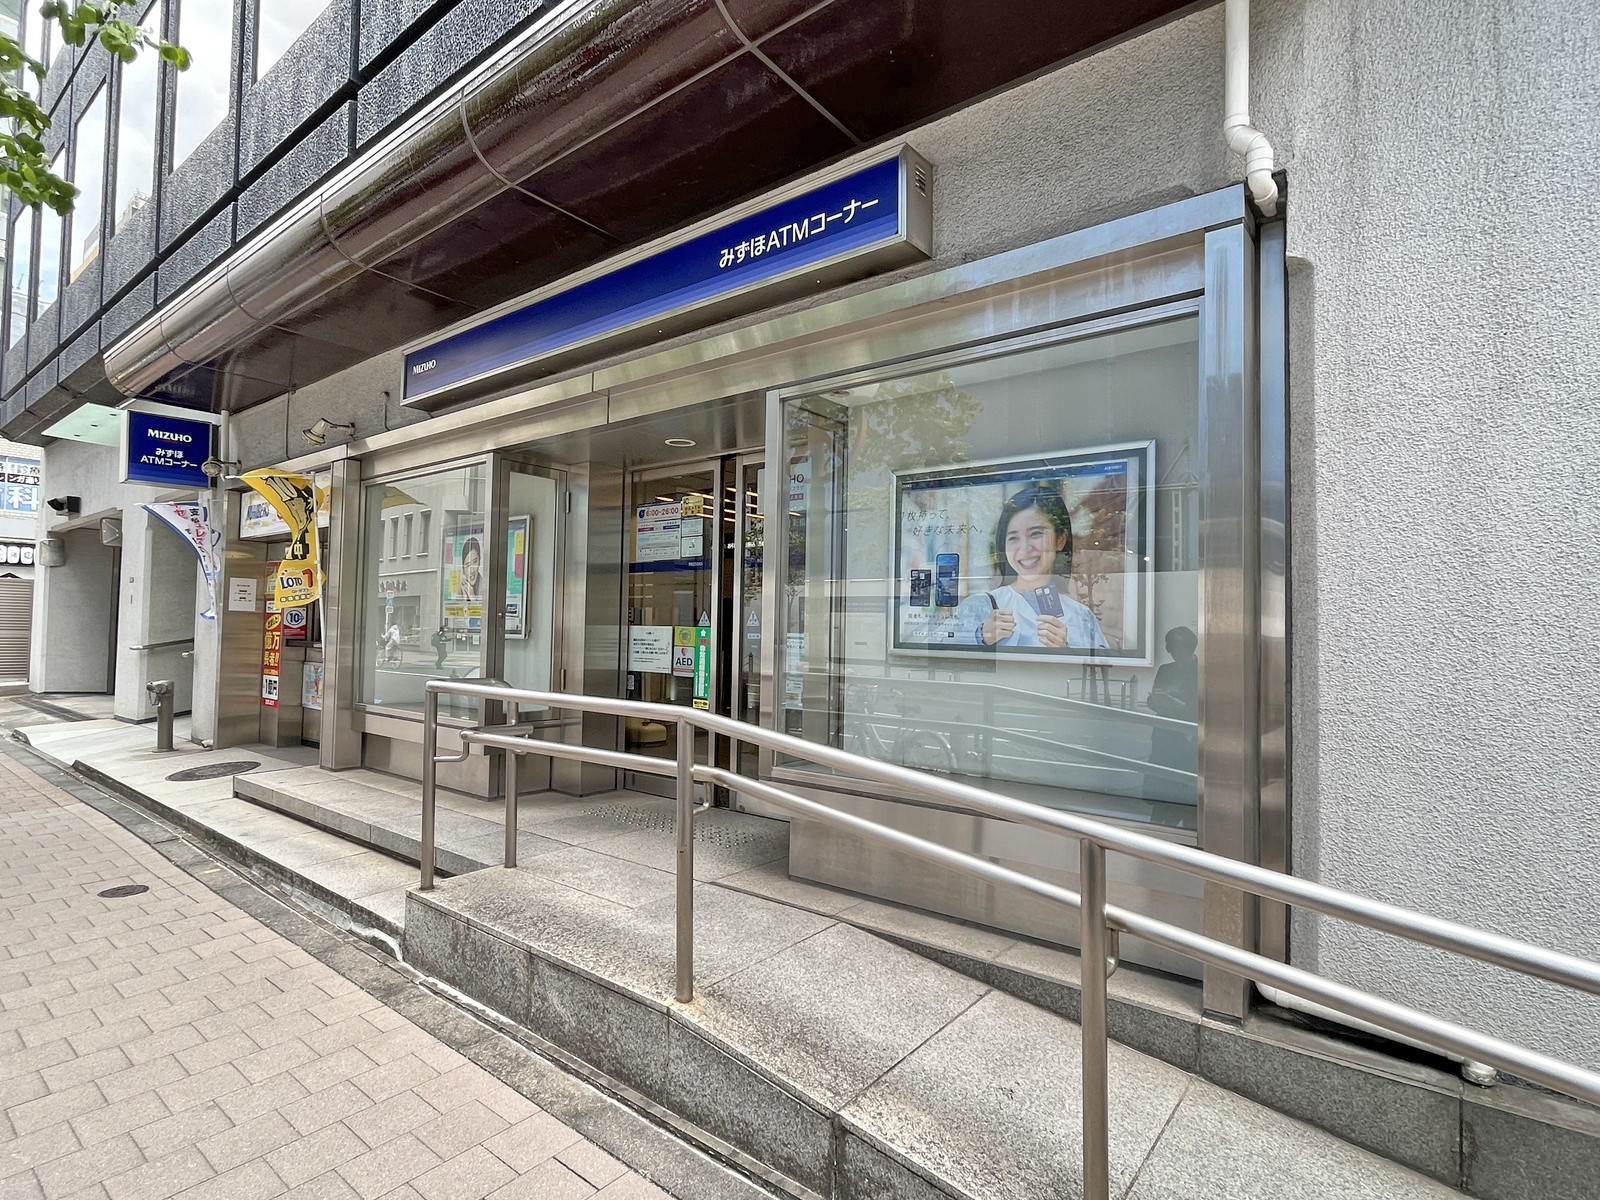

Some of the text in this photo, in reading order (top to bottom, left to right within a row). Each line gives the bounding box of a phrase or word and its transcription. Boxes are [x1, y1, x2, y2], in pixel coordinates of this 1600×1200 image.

[719, 199, 879, 268] みずほATMコーナー
[412, 359, 437, 375] MIZUHO
[147, 429, 192, 443] MIZUHO
[155, 447, 184, 459] みずほ
[140, 455, 198, 468] ATMコーナー
[675, 657, 693, 667] AED
